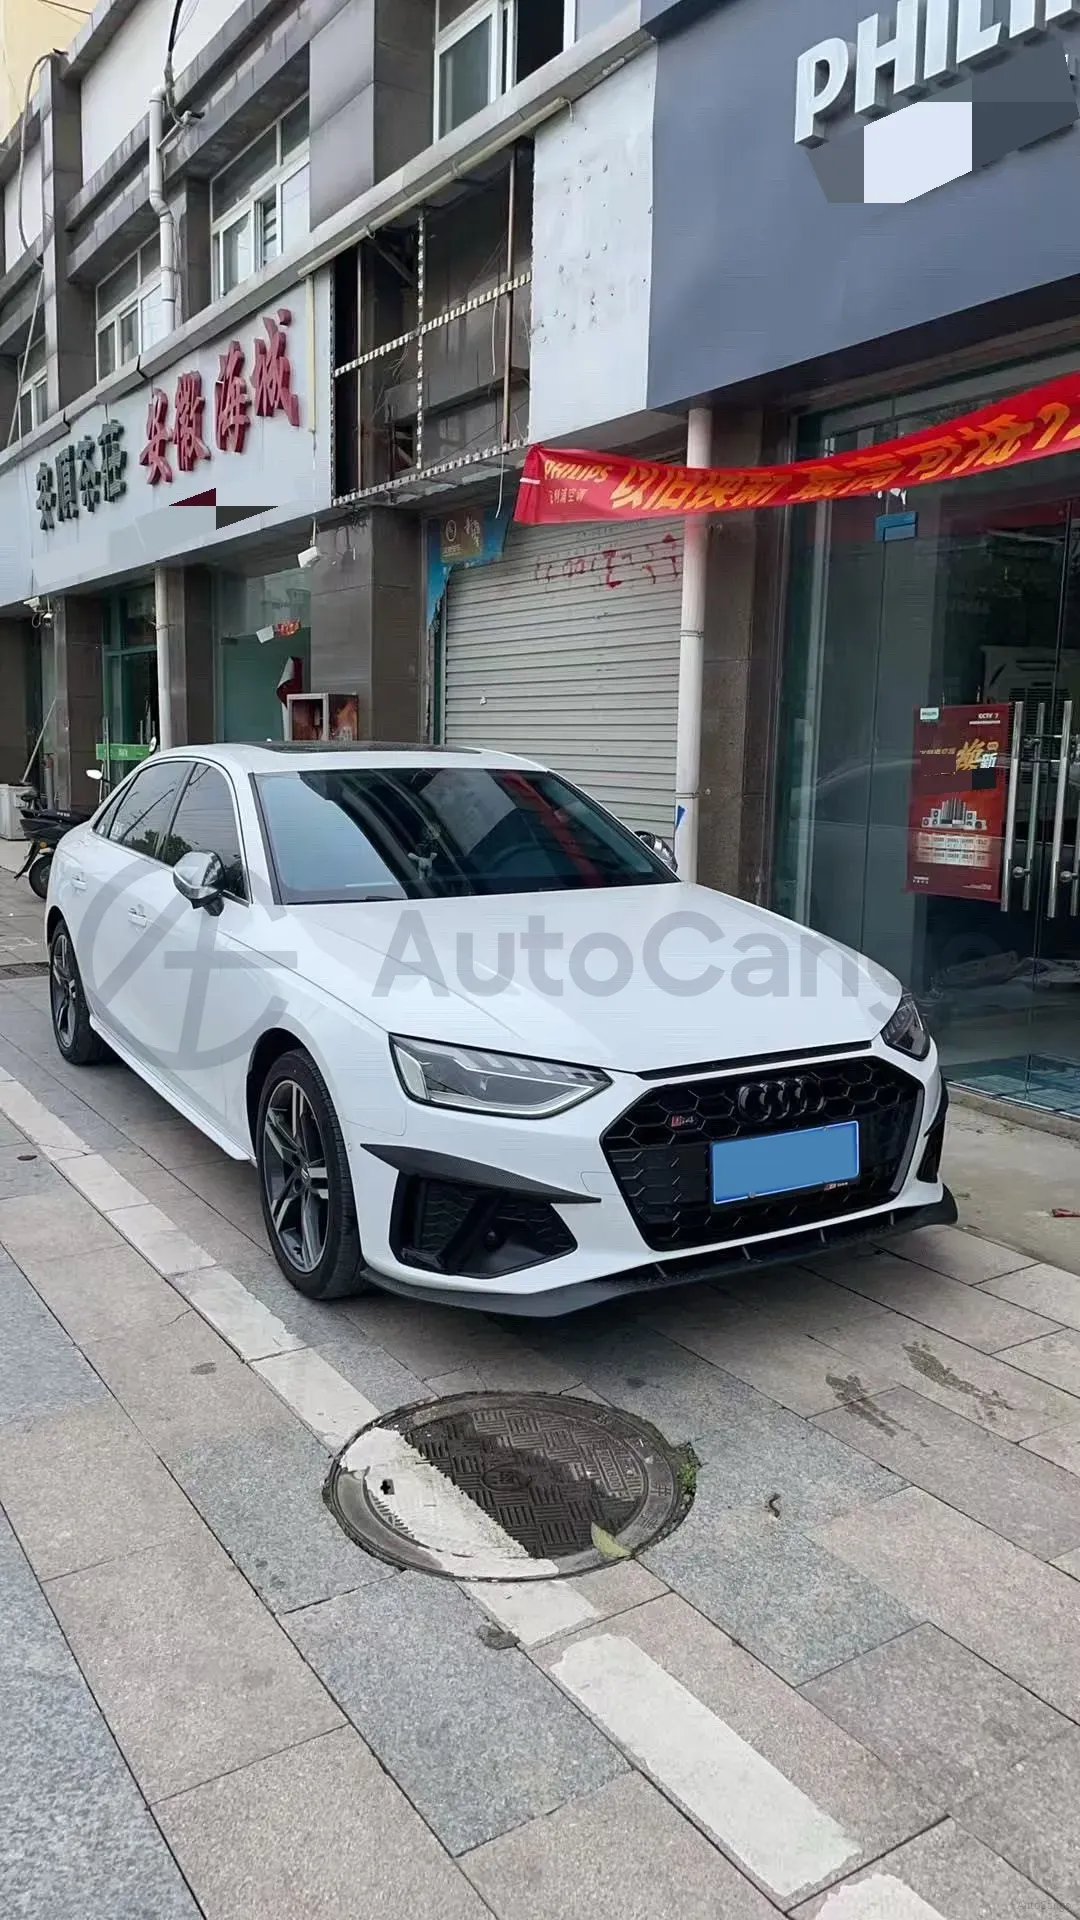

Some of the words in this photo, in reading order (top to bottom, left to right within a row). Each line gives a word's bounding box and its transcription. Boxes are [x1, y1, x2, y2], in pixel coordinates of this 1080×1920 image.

[794, 0, 1072, 144] PHIL
[544, 459, 624, 483] PHILIPS
[610, 465, 793, 510] 以旧换新
